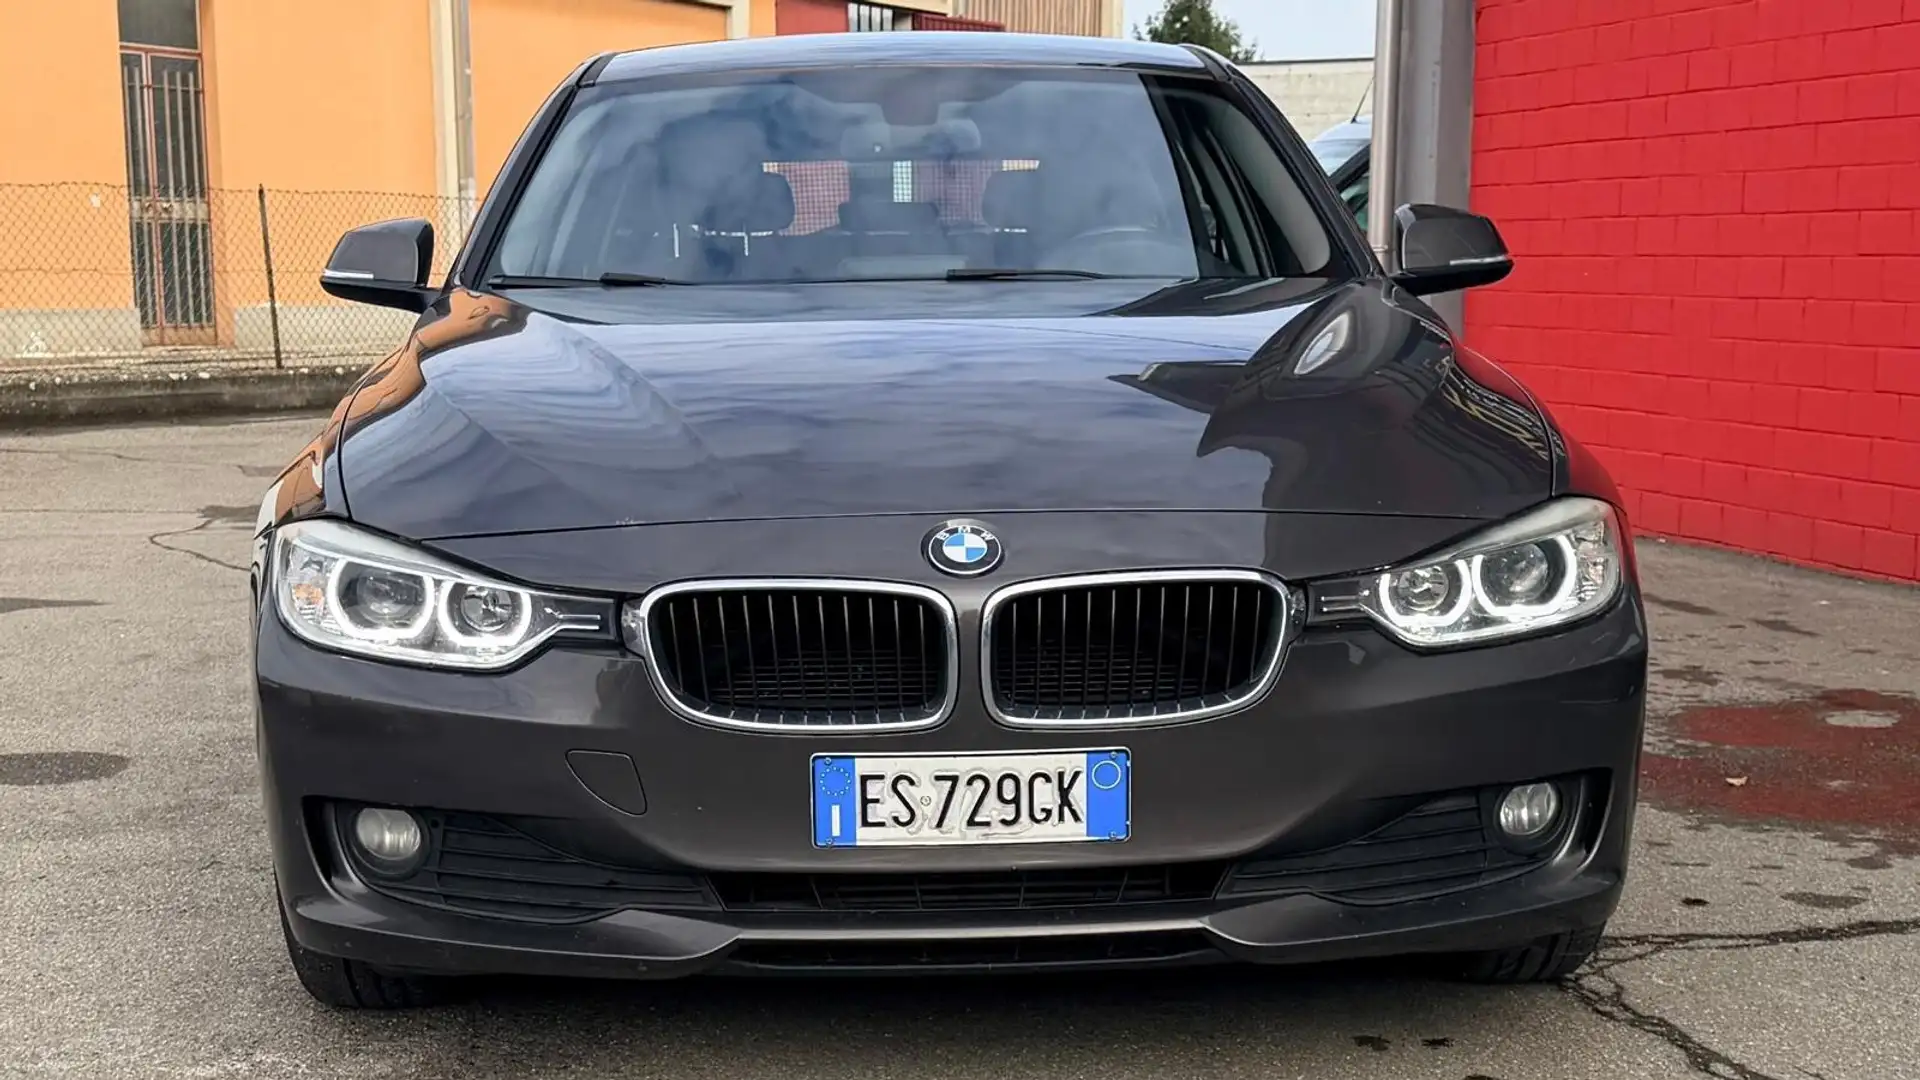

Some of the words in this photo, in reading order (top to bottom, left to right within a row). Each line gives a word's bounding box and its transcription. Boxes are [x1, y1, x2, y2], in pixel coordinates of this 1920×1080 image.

[935, 525, 995, 541] BMW
[859, 772, 917, 828] ES
[933, 770, 1083, 829] 729GK
[831, 804, 841, 837] I
